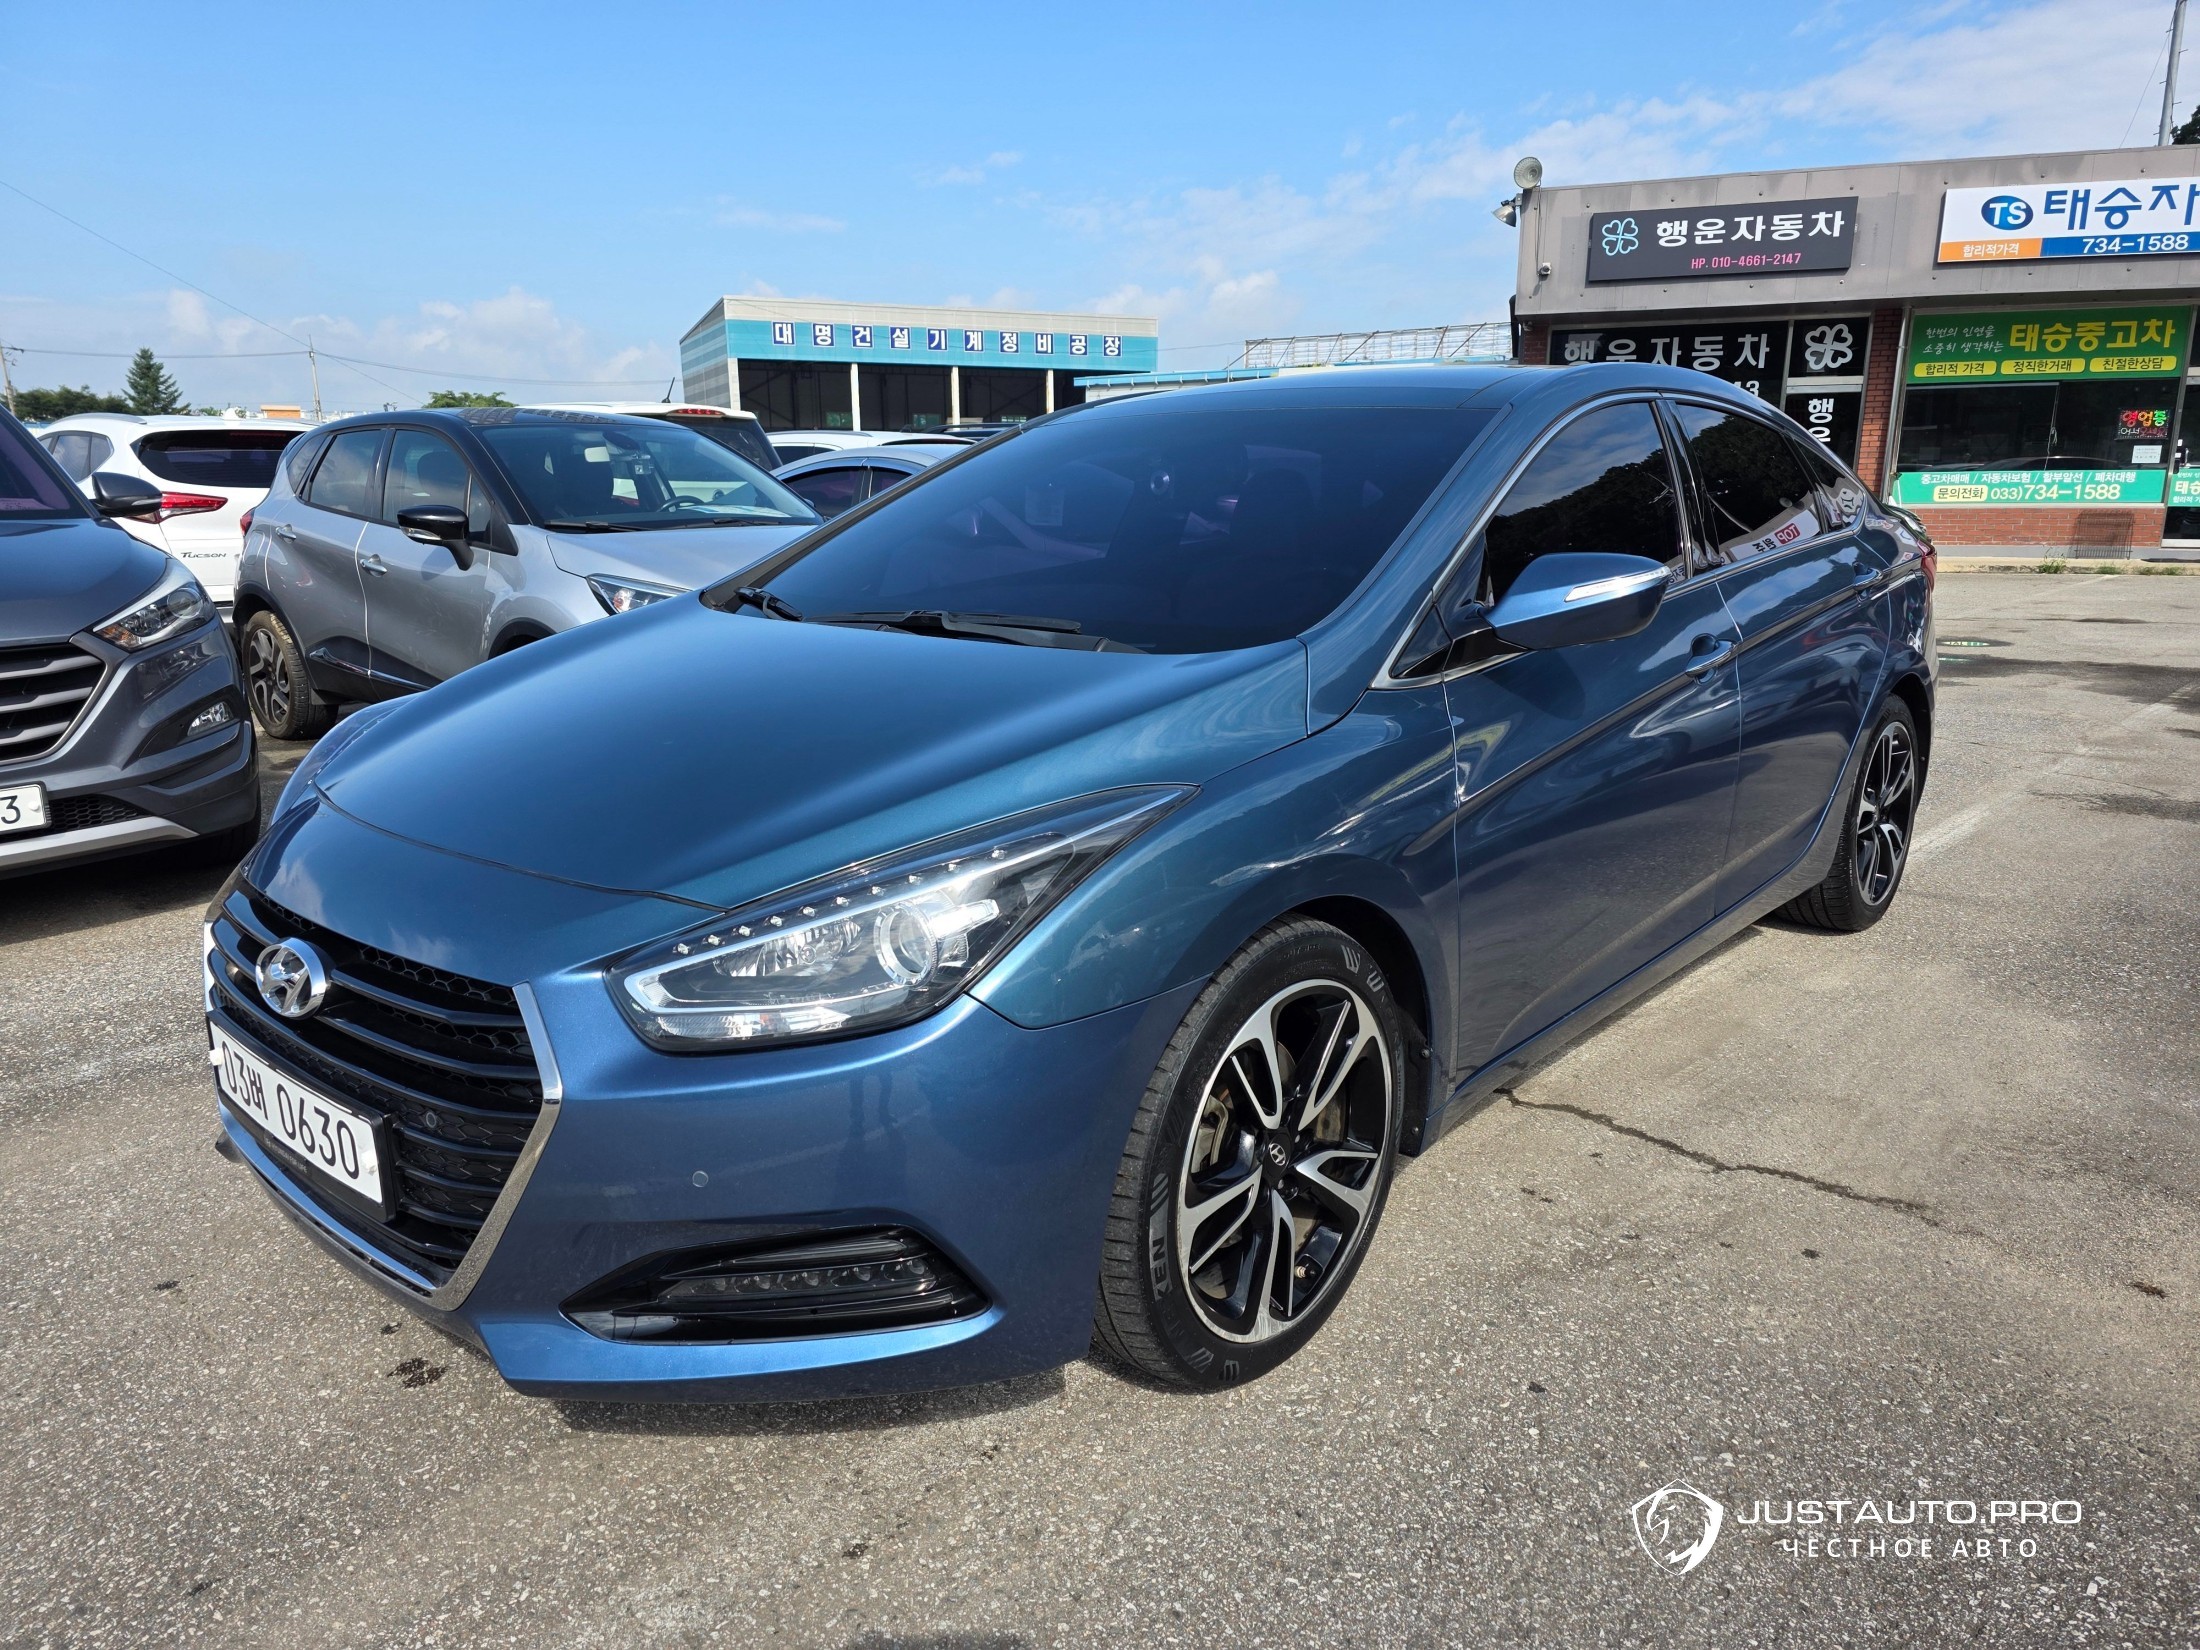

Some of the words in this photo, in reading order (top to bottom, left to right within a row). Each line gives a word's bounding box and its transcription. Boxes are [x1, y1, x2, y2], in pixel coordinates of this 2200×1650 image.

[1989, 201, 2028, 226] TS
[1656, 210, 1845, 247] 행운자동차
[1963, 243, 2020, 258] 합리적가격
[2082, 234, 2189, 254] 734-1588
[1691, 257, 1709, 269] HP.
[1711, 253, 1802, 268] 010-4661-2147
[1926, 327, 1958, 338] 한번의
[1963, 325, 1995, 338] 인연을
[2009, 319, 2175, 353] 태승중고차
[1923, 342, 1956, 355] 소중히
[1961, 341, 2004, 353] 생각하는
[1926, 363, 1958, 375] 합리적
[1962, 362, 1985, 374] 가격
[2013, 359, 2072, 372] 정직한거래
[2103, 357, 2164, 371] 친절한상담
[2122, 410, 2166, 427] 영업중
[1921, 474, 1970, 484] 중고차매매
[1981, 473, 2031, 484] 자동차보험
[2043, 472, 2084, 483] 할부알선
[2094, 472, 2136, 483] 폐차대행
[1938, 488, 1984, 499] 문의전화
[222, 1041, 269, 1121] 03배
[276, 1083, 360, 1180] 0630
